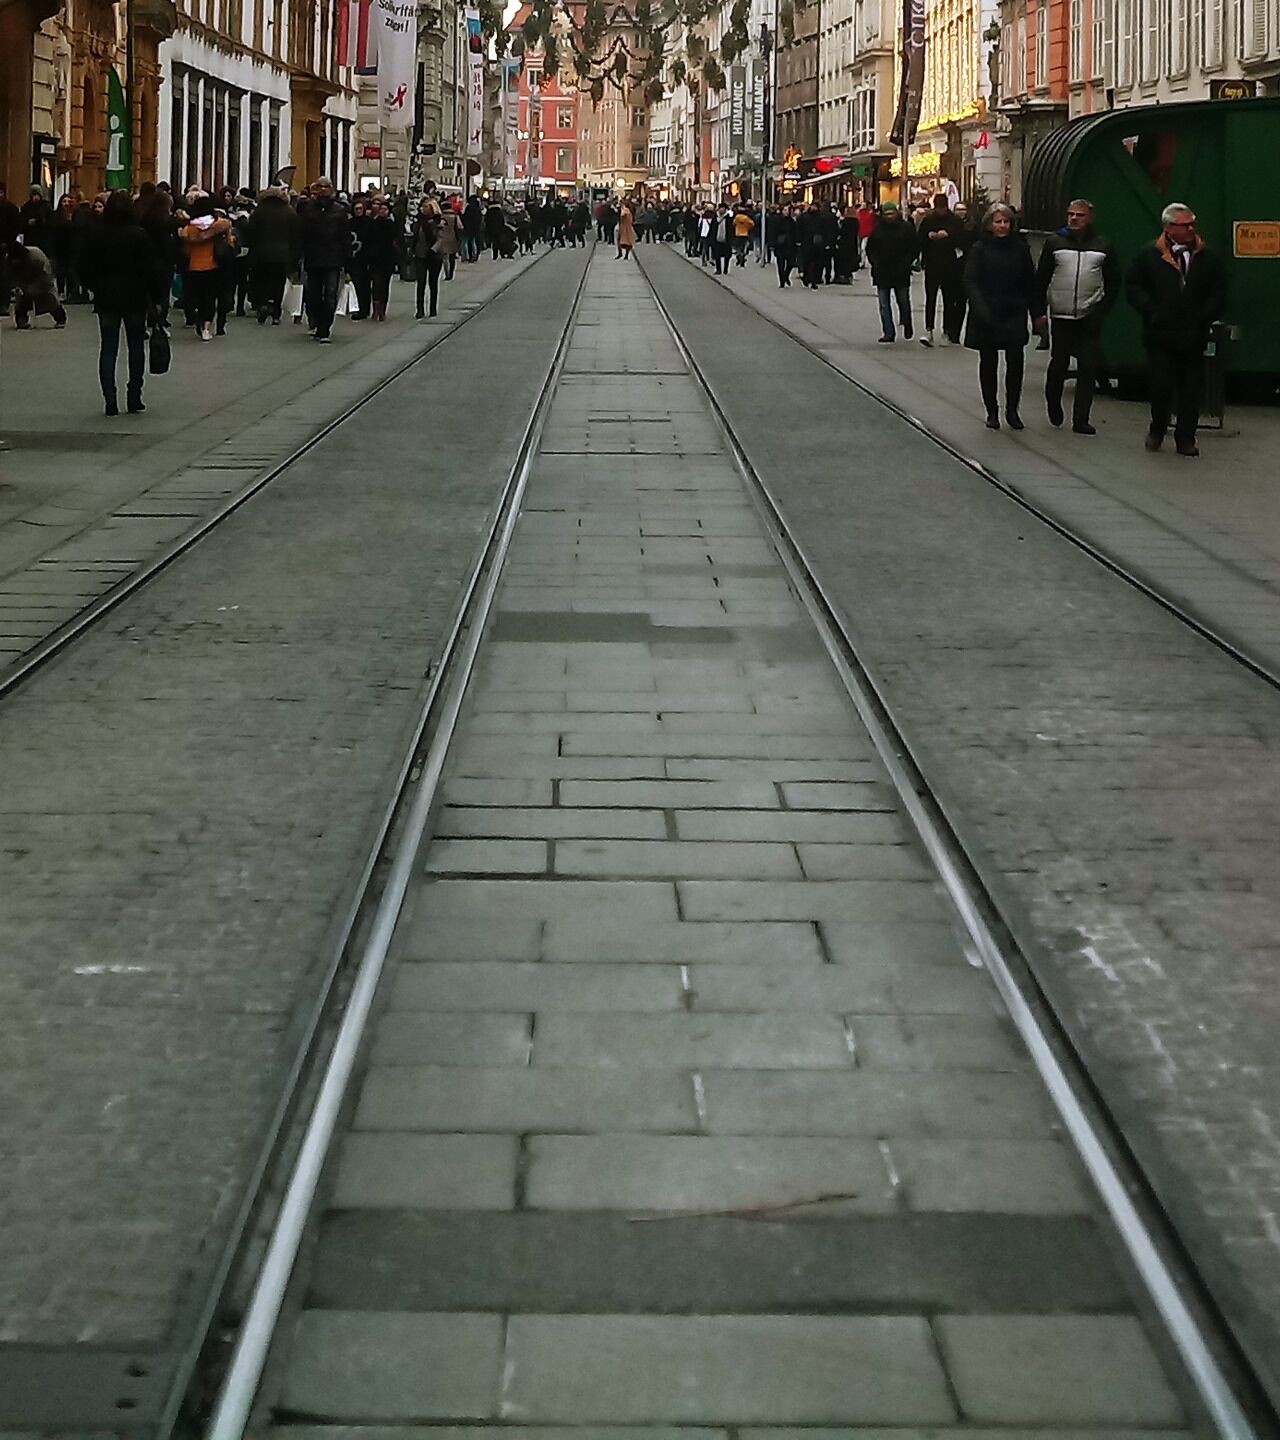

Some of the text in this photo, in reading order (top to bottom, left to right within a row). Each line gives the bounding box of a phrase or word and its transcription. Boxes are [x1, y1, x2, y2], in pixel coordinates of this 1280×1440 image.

[732, 80, 744, 135] HUMANIC
[753, 74, 765, 132] HUMANIC
[106, 113, 125, 172] i
